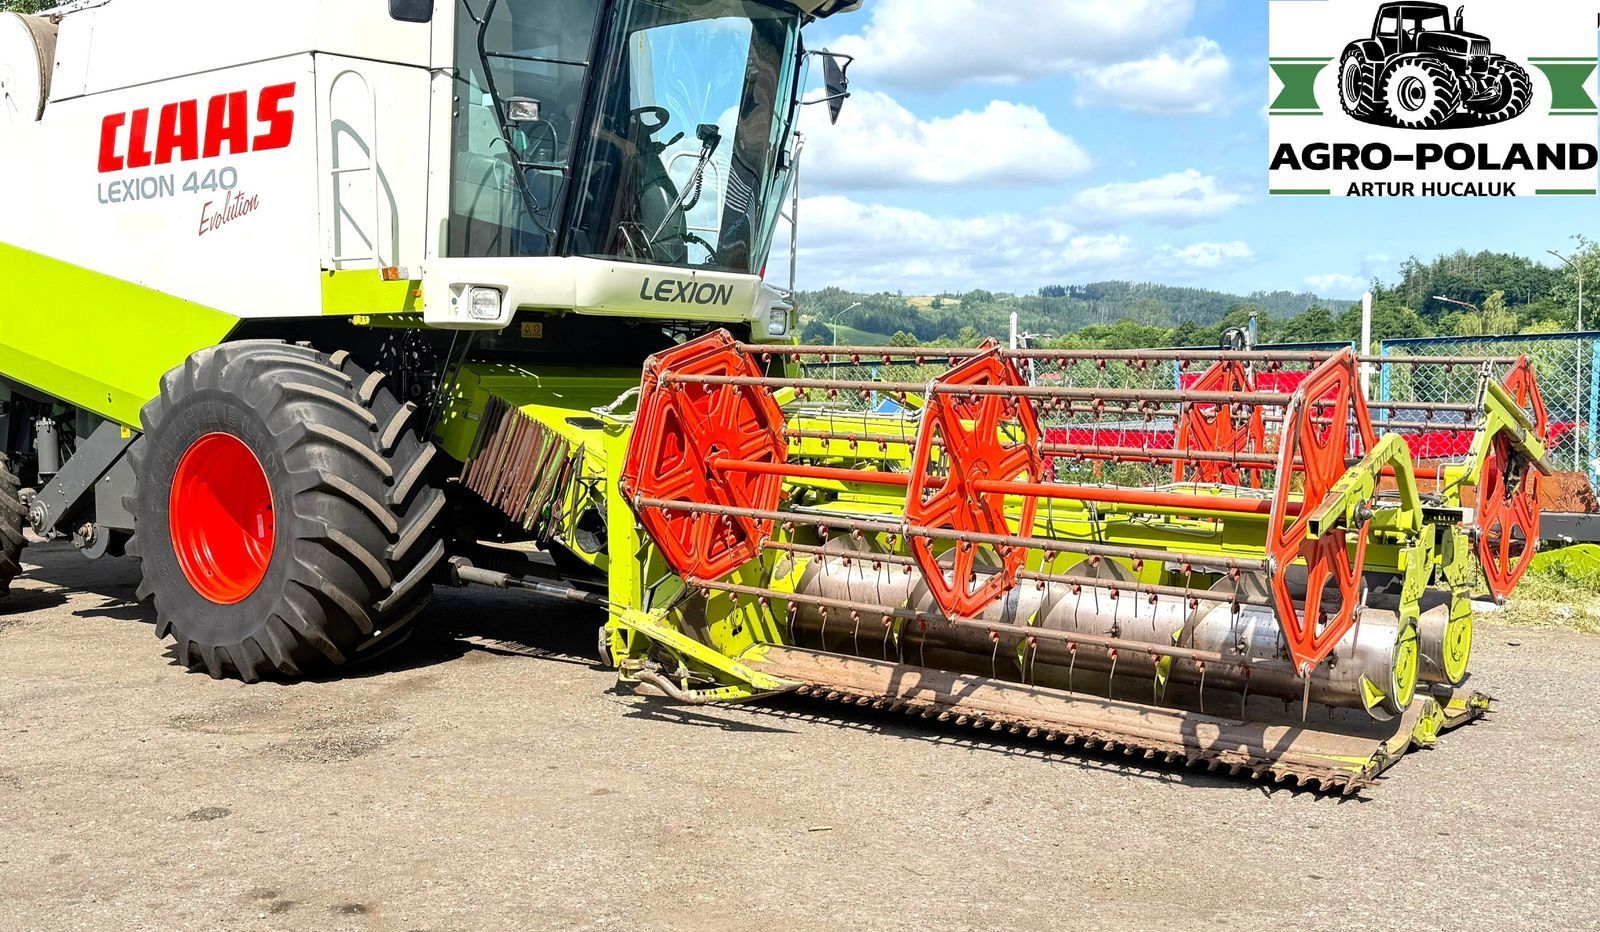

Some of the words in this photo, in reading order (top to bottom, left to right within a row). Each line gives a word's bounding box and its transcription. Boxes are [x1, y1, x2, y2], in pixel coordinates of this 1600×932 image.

[98, 82, 296, 173] CLAAS
[98, 174, 174, 204] LEXION
[182, 166, 238, 194] 440
[199, 190, 260, 236] Evolution
[640, 278, 734, 306] LEXION
